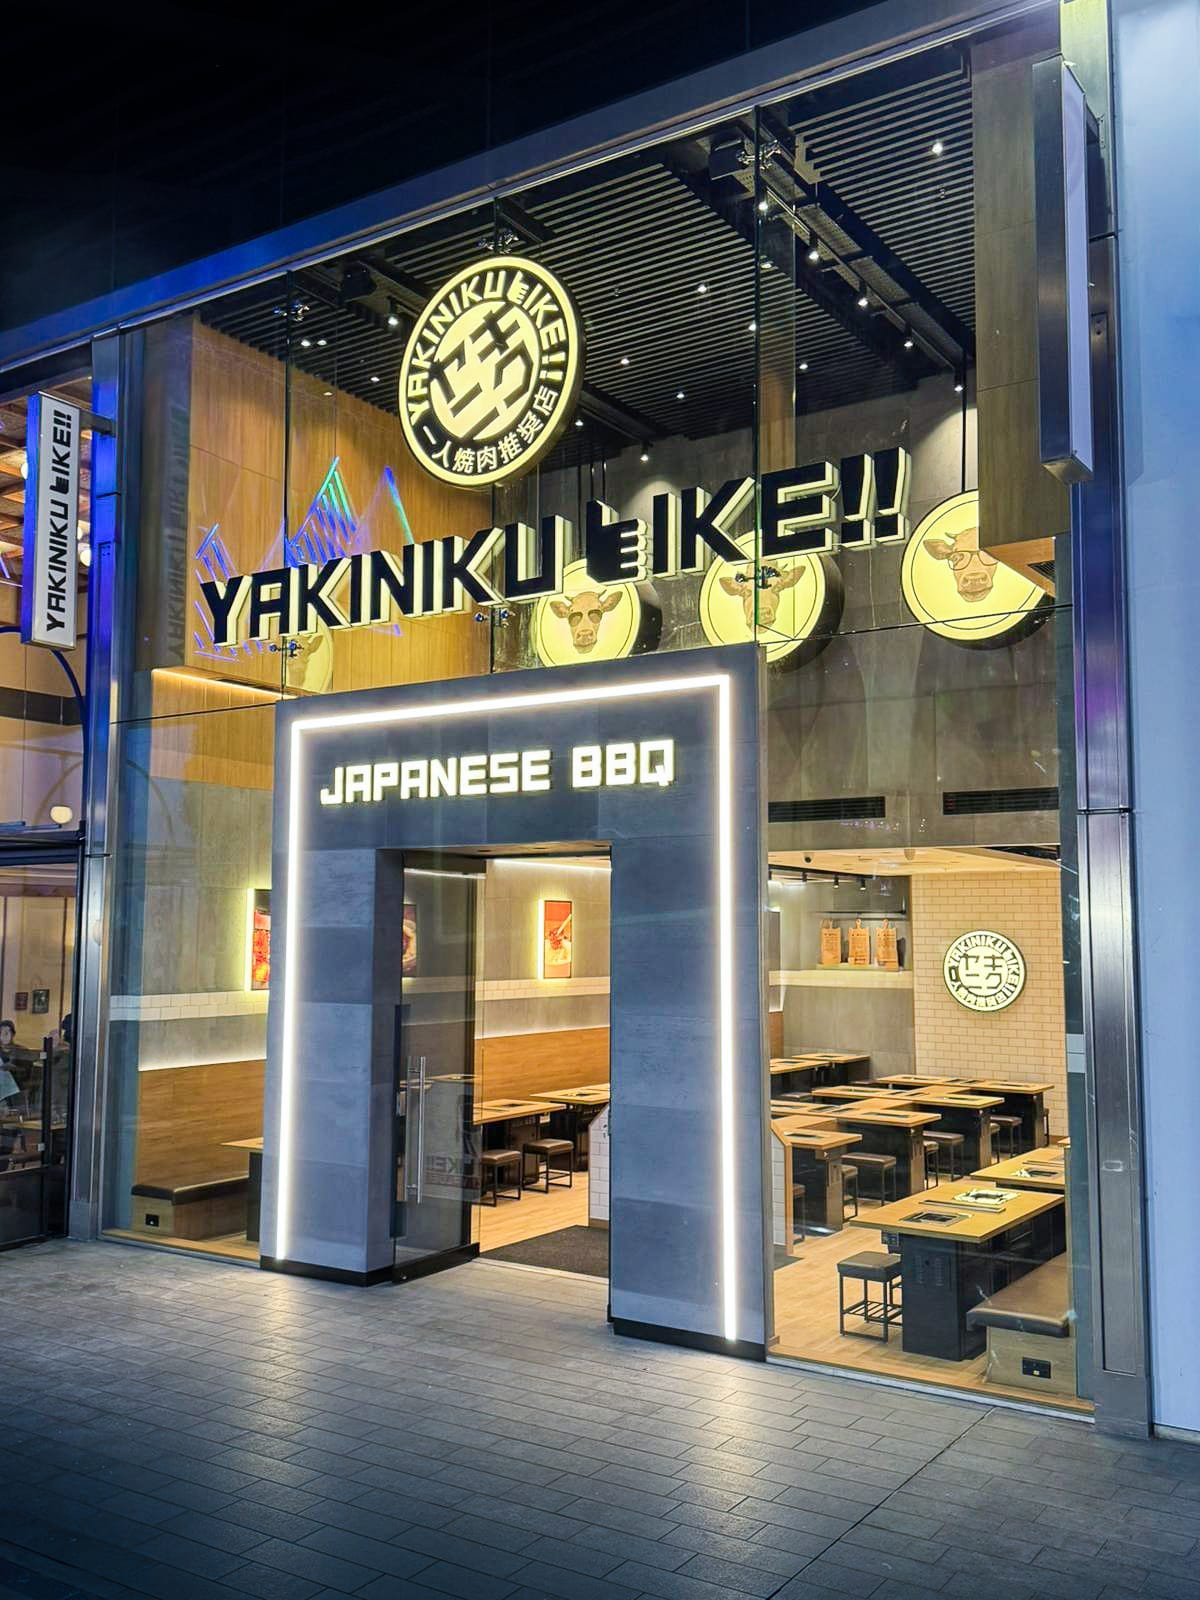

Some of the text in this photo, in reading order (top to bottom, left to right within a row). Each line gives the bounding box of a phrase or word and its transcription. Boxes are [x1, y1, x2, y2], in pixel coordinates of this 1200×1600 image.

[408, 270, 507, 426] YAKINIKU
[46, 499, 69, 632] YAKINIKU
[200, 514, 567, 646] YAKINIKU
[320, 739, 674, 804] JAPANESE BBQ
[947, 934, 1007, 968] YAKINIKU
